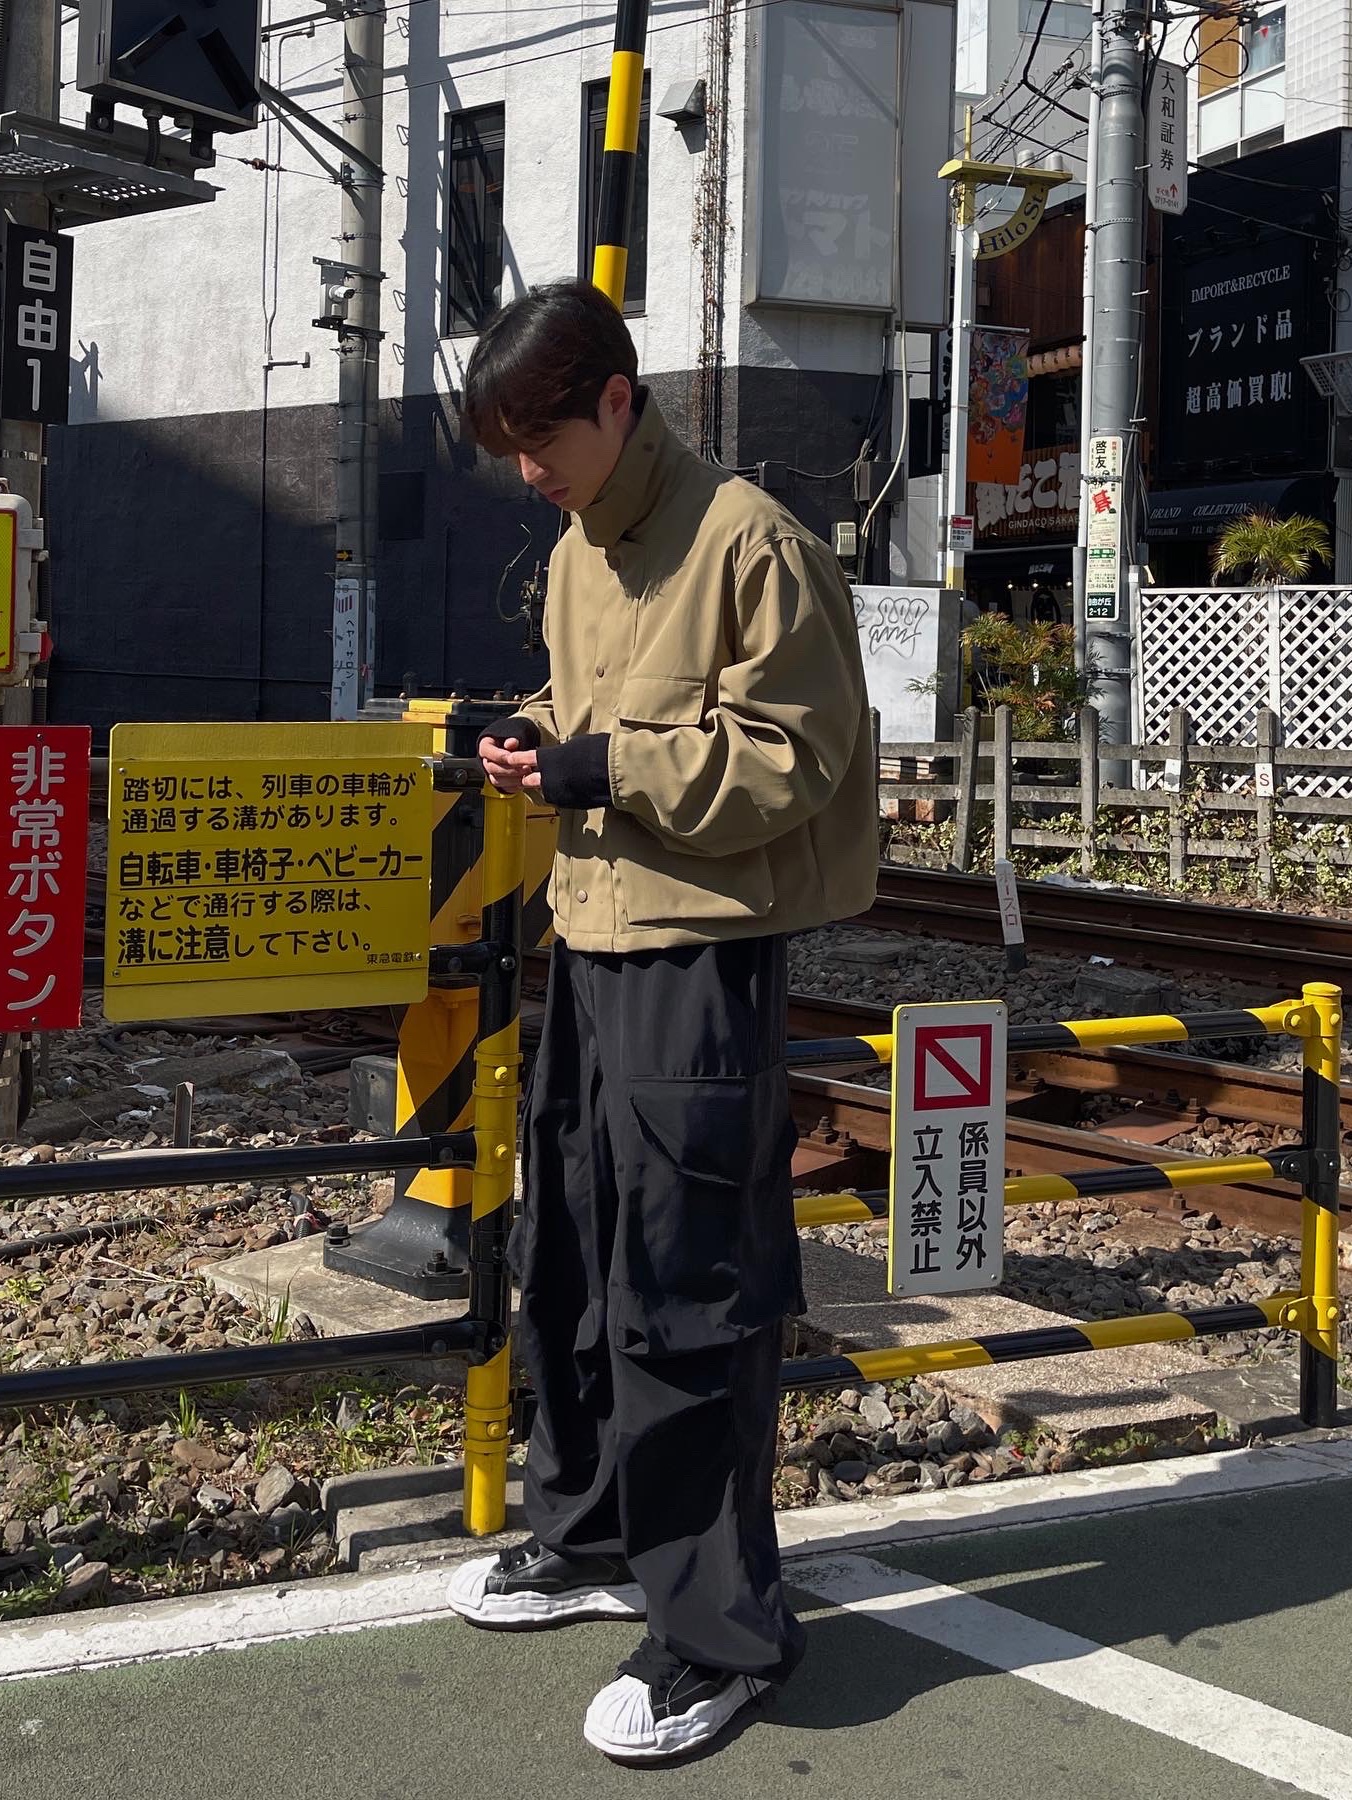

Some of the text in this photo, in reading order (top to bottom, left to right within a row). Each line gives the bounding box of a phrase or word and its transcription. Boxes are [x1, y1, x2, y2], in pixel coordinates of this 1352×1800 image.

[1160, 71, 1175, 171] 大和証券
[979, 188, 1044, 254] Hilo St.
[1191, 264, 1291, 303] IMPORT&RECYCLE
[18, 238, 57, 411] 自由1
[1187, 308, 1292, 358] ブランド品
[1185, 369, 1292, 416] 超高価買取!
[1008, 518, 1047, 529] GINDACO
[1150, 502, 1252, 520] BRAND COLLECTION
[1088, 607, 1108, 616] 2-12
[122, 771, 417, 802] 踏切には、列車の車輪が
[1259, 773, 1270, 786] S
[121, 802, 399, 835] 通過する溝があります。
[7, 745, 67, 1010] 非常ボタン
[119, 844, 423, 887] 自転車・車椅子・ベビーカー
[119, 888, 373, 922] などで通行する際は、
[117, 923, 373, 963] 溝に注意して下さい。
[910, 1124, 943, 1276] 立入禁止
[955, 1120, 990, 1270] 係員以外
